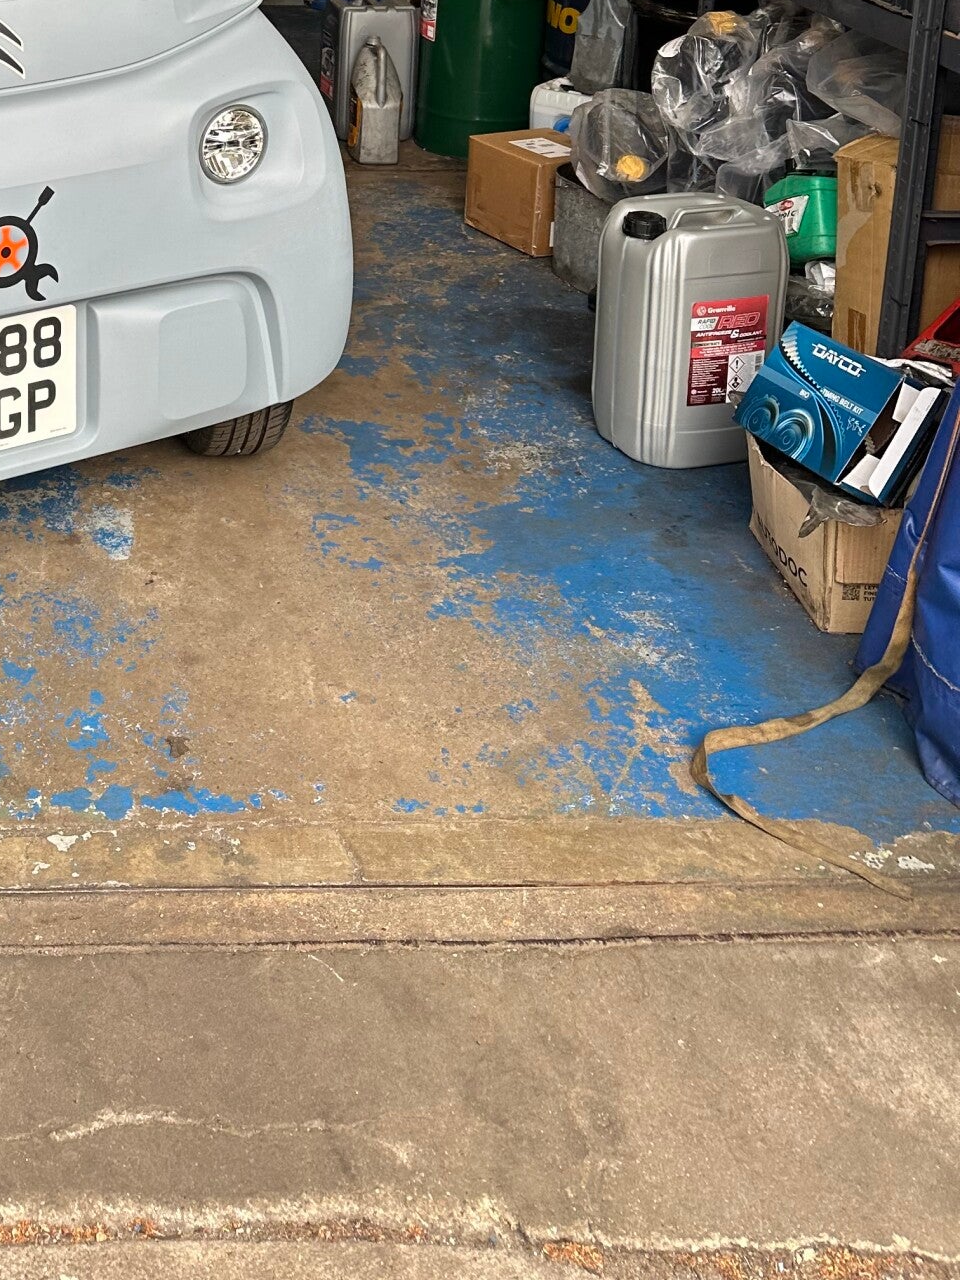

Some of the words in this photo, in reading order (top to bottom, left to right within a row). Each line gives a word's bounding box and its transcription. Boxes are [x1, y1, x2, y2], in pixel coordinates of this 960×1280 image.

[707, 305, 736, 314] Granville
[717, 311, 761, 330] RED
[739, 330, 763, 338] COOLANT
[811, 343, 867, 378] DAYCO
[839, 396, 856, 410] BELT
[852, 404, 865, 415] KIT
